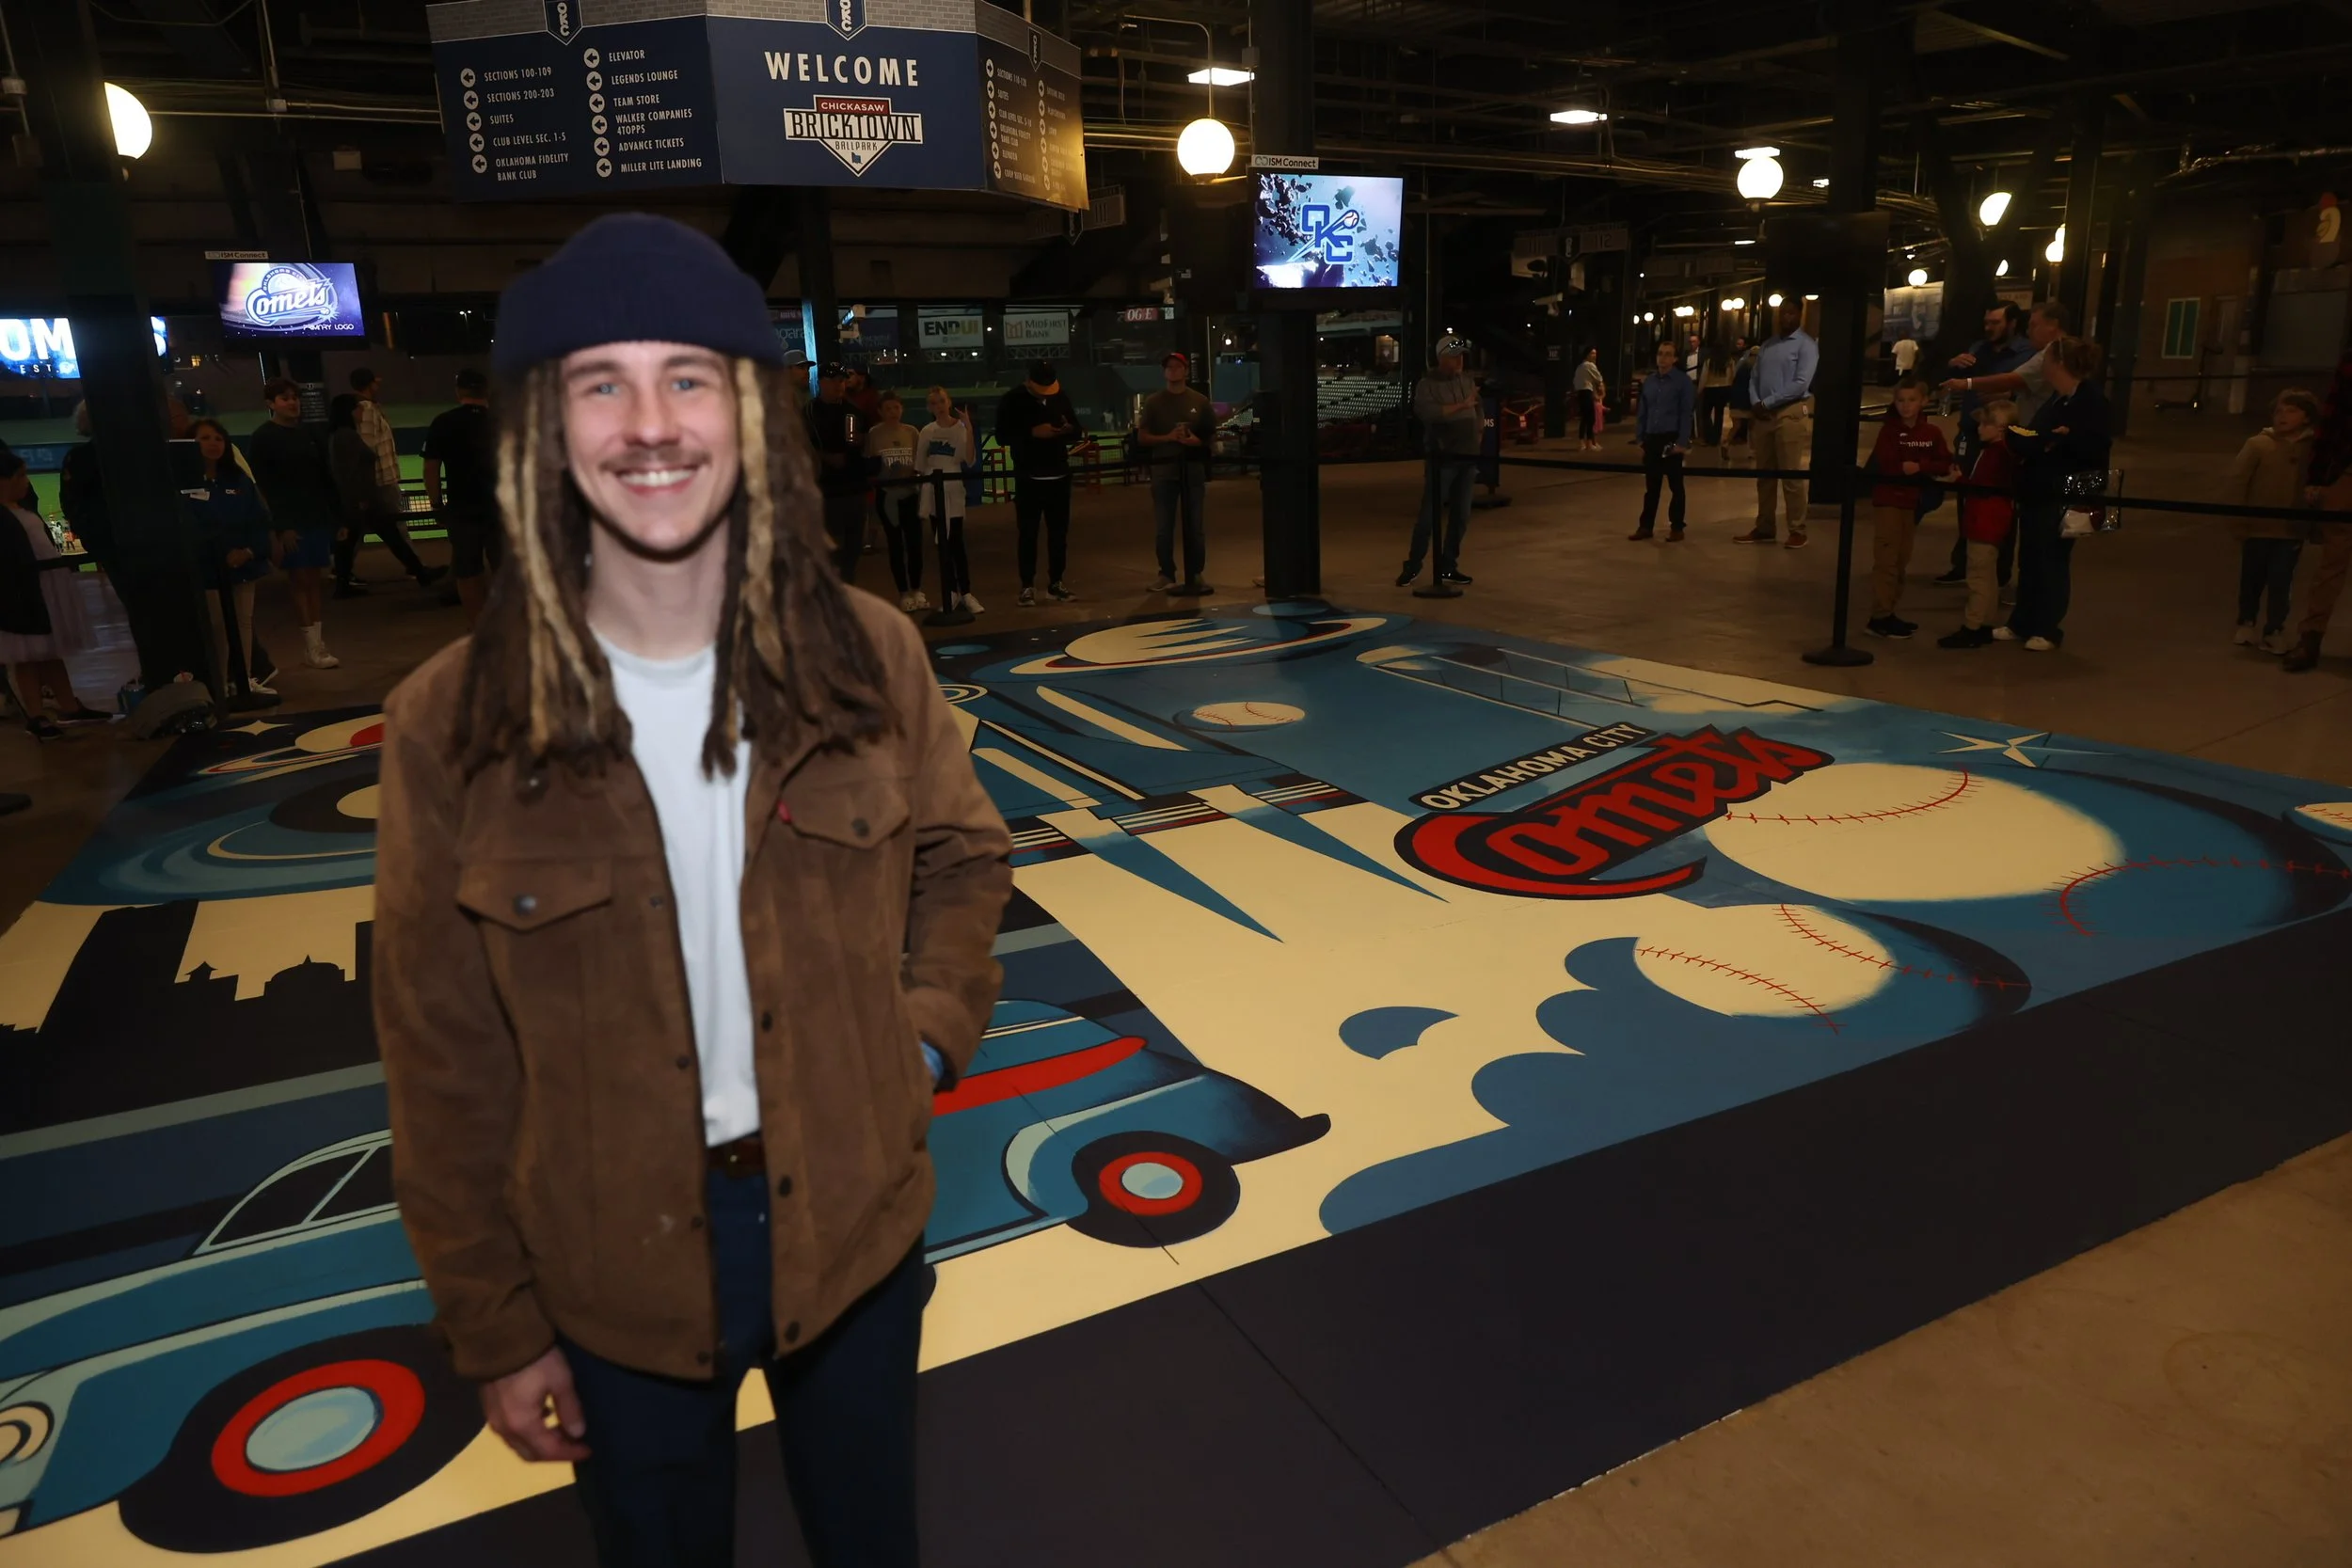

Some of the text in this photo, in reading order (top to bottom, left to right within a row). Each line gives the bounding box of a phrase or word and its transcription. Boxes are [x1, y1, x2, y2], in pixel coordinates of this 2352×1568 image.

[609, 49, 645, 62] ELEVATOR
[484, 66, 552, 82] SECTIONS 100-109
[764, 51, 920, 87] WELCOME
[611, 70, 678, 86] LEGENDS LOUNGE
[486, 87, 555, 103] SECTIONS 200-203
[613, 94, 660, 107] TEAM STORE
[820, 102, 885, 112] CHICKASAW
[489, 114, 514, 125] SUITES
[615, 108, 692, 123] WALKER COMPANIES
[616, 124, 645, 135] 4TOPPS
[791, 112, 916, 141] BRICKTOWN
[493, 132, 566, 147] CLUB LEVEL SEC. 1-5
[618, 137, 685, 152] ADVANCE TICKETS
[834, 141, 878, 151] BALLPARK
[495, 152, 569, 167] OKLAHOMA FIDELITY
[620, 157, 703, 173] MILLER LITE LANDING
[1269, 157, 1316, 167] ISM Connect
[497, 169, 537, 182] BANK CLUB
[1301, 204, 1354, 262] OKC
[1420, 722, 1649, 811] OKLAHOMA CITY
[1411, 725, 1823, 897] Comets
